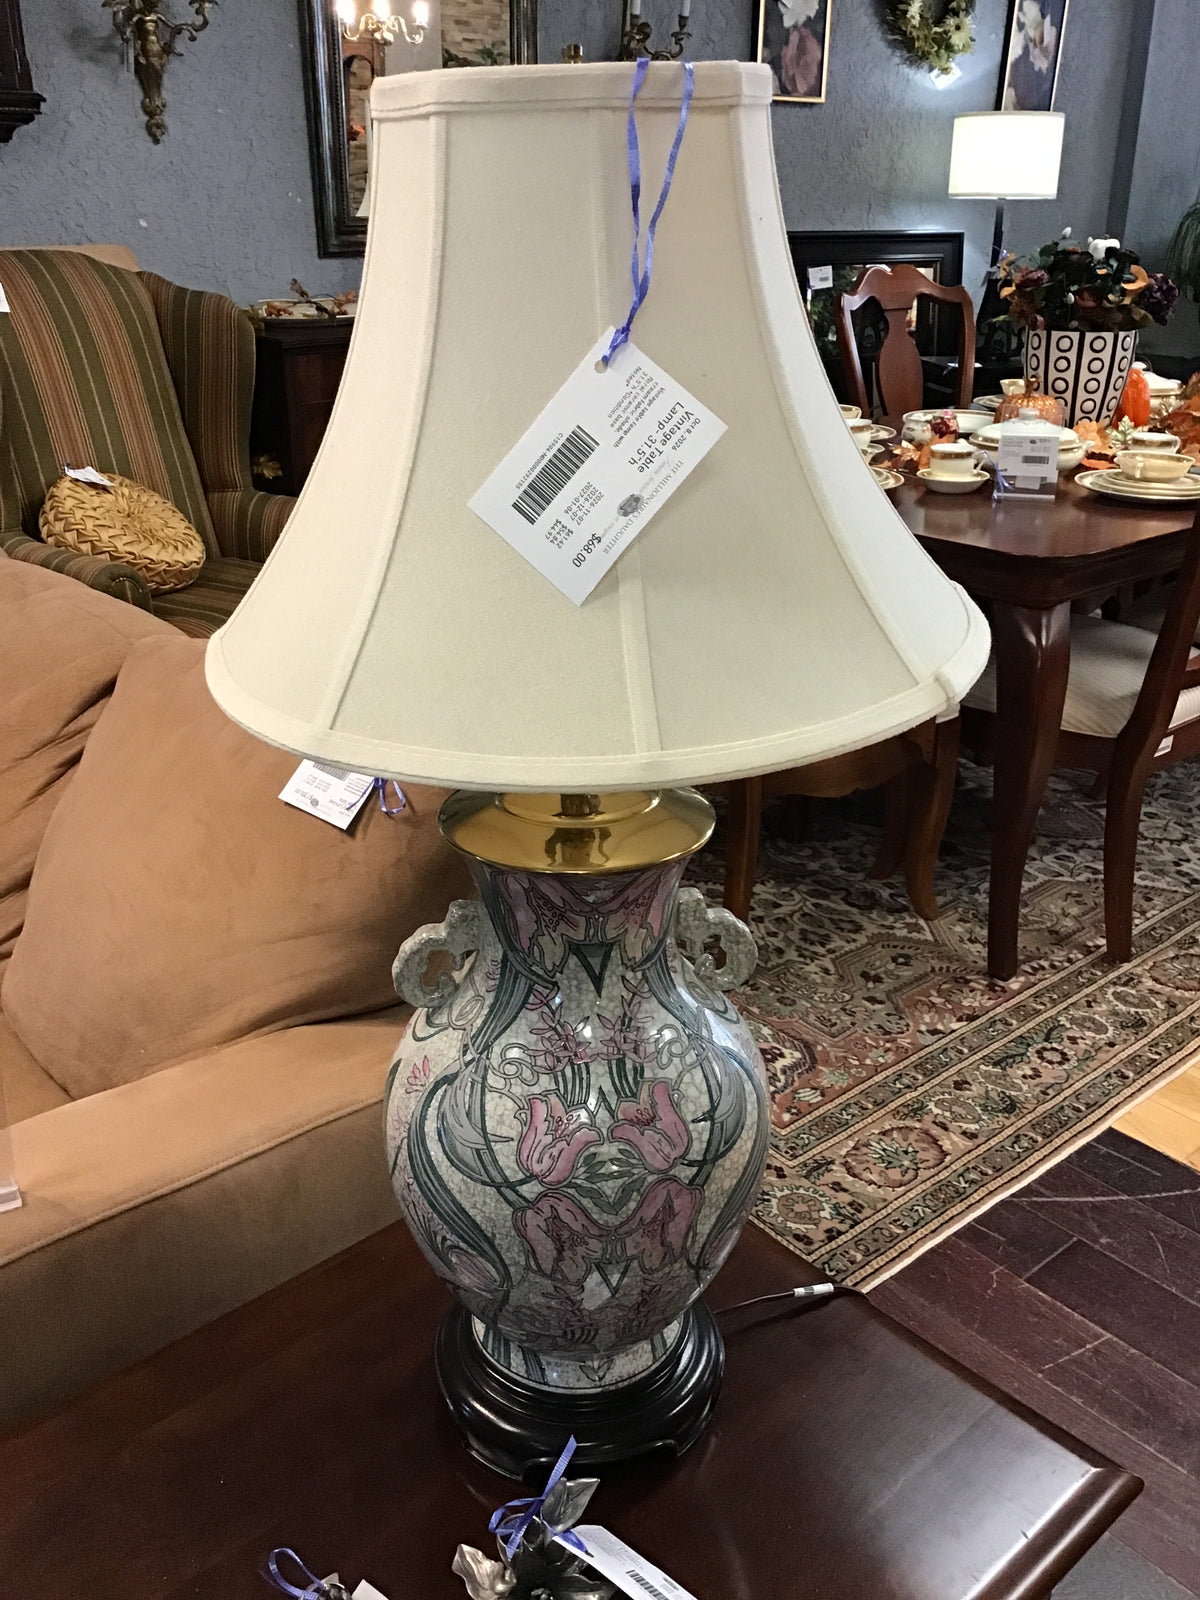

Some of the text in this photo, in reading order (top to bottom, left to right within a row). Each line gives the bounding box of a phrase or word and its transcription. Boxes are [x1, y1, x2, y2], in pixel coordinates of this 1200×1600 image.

[638, 375, 654, 392] floral
[641, 380, 659, 400] cream
[609, 413, 622, 428] base
[612, 385, 665, 449] Vintage table lamp with
[629, 398, 645, 416] fabric
[651, 400, 684, 436] Lamp-
[689, 416, 701, 429] Oct
[657, 408, 694, 448] Vintage
[670, 433, 686, 452] 2026
[636, 445, 663, 475] Table
[670, 459, 683, 474] THE
[543, 480, 593, 540] 2027-01-06 $44.97
[548, 486, 599, 545] 2026-12-07 $54.84
[574, 490, 604, 526] 2026-11-07
[570, 531, 602, 568] $68.00
[602, 517, 633, 554] DAUGHTER
